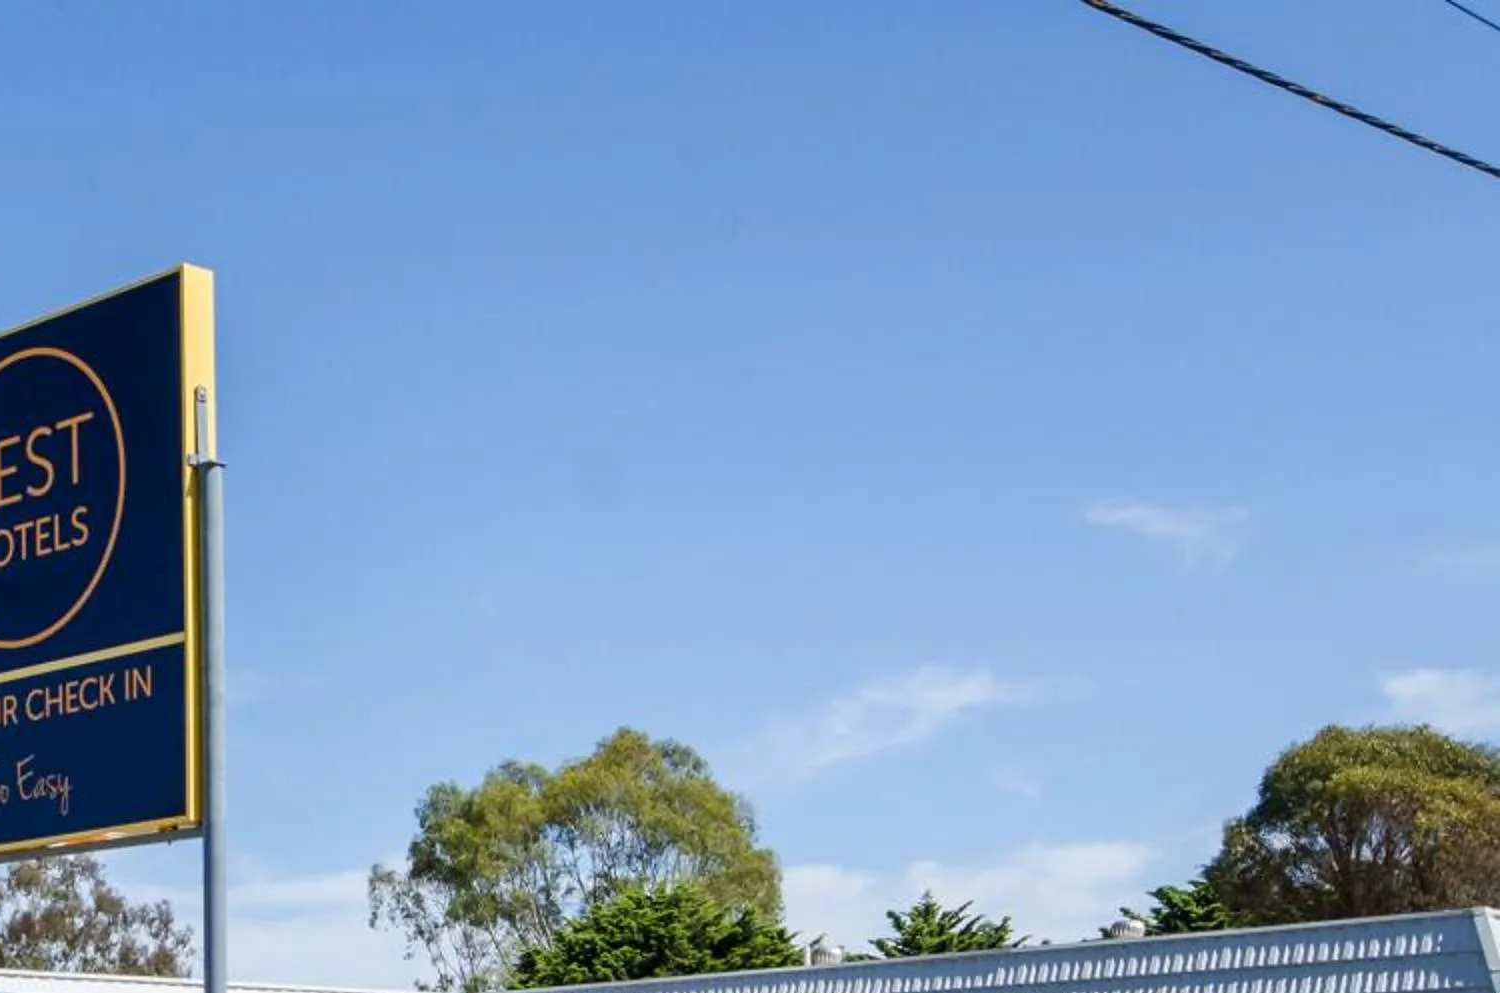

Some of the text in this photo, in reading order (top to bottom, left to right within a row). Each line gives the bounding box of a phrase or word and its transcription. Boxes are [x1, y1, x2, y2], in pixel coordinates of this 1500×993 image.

[25, 673, 116, 722] CHECK
[124, 665, 152, 701] IN
[17, 754, 72, 815] Easy
